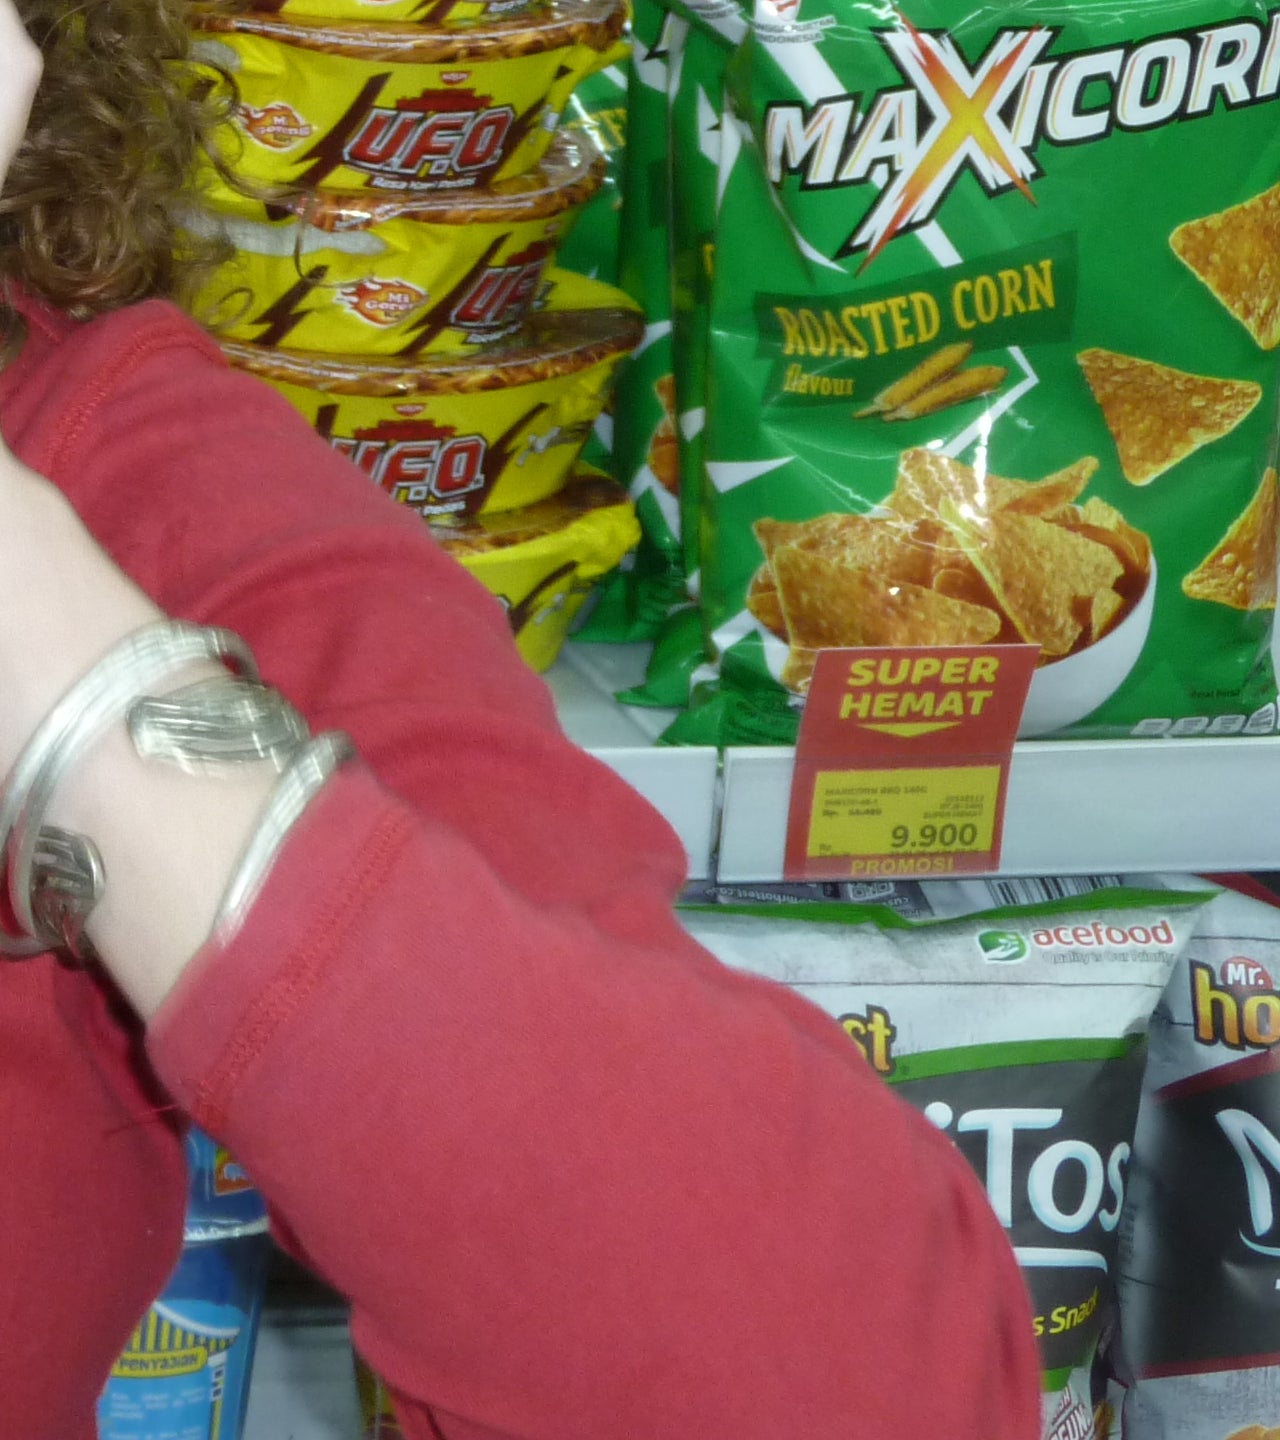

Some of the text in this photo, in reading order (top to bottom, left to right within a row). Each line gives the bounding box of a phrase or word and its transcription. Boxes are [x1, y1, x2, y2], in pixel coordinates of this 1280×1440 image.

[388, 292, 409, 302] Mi
[775, 258, 1056, 356] ROASTED CORN
[847, 657, 1000, 687] SUPER
[839, 690, 994, 719] HEMAT
[891, 823, 978, 847] 9.900
[852, 858, 955, 875] PROMOSI
[1033, 920, 1174, 946] acefood
[1227, 963, 1264, 986] Mr.
